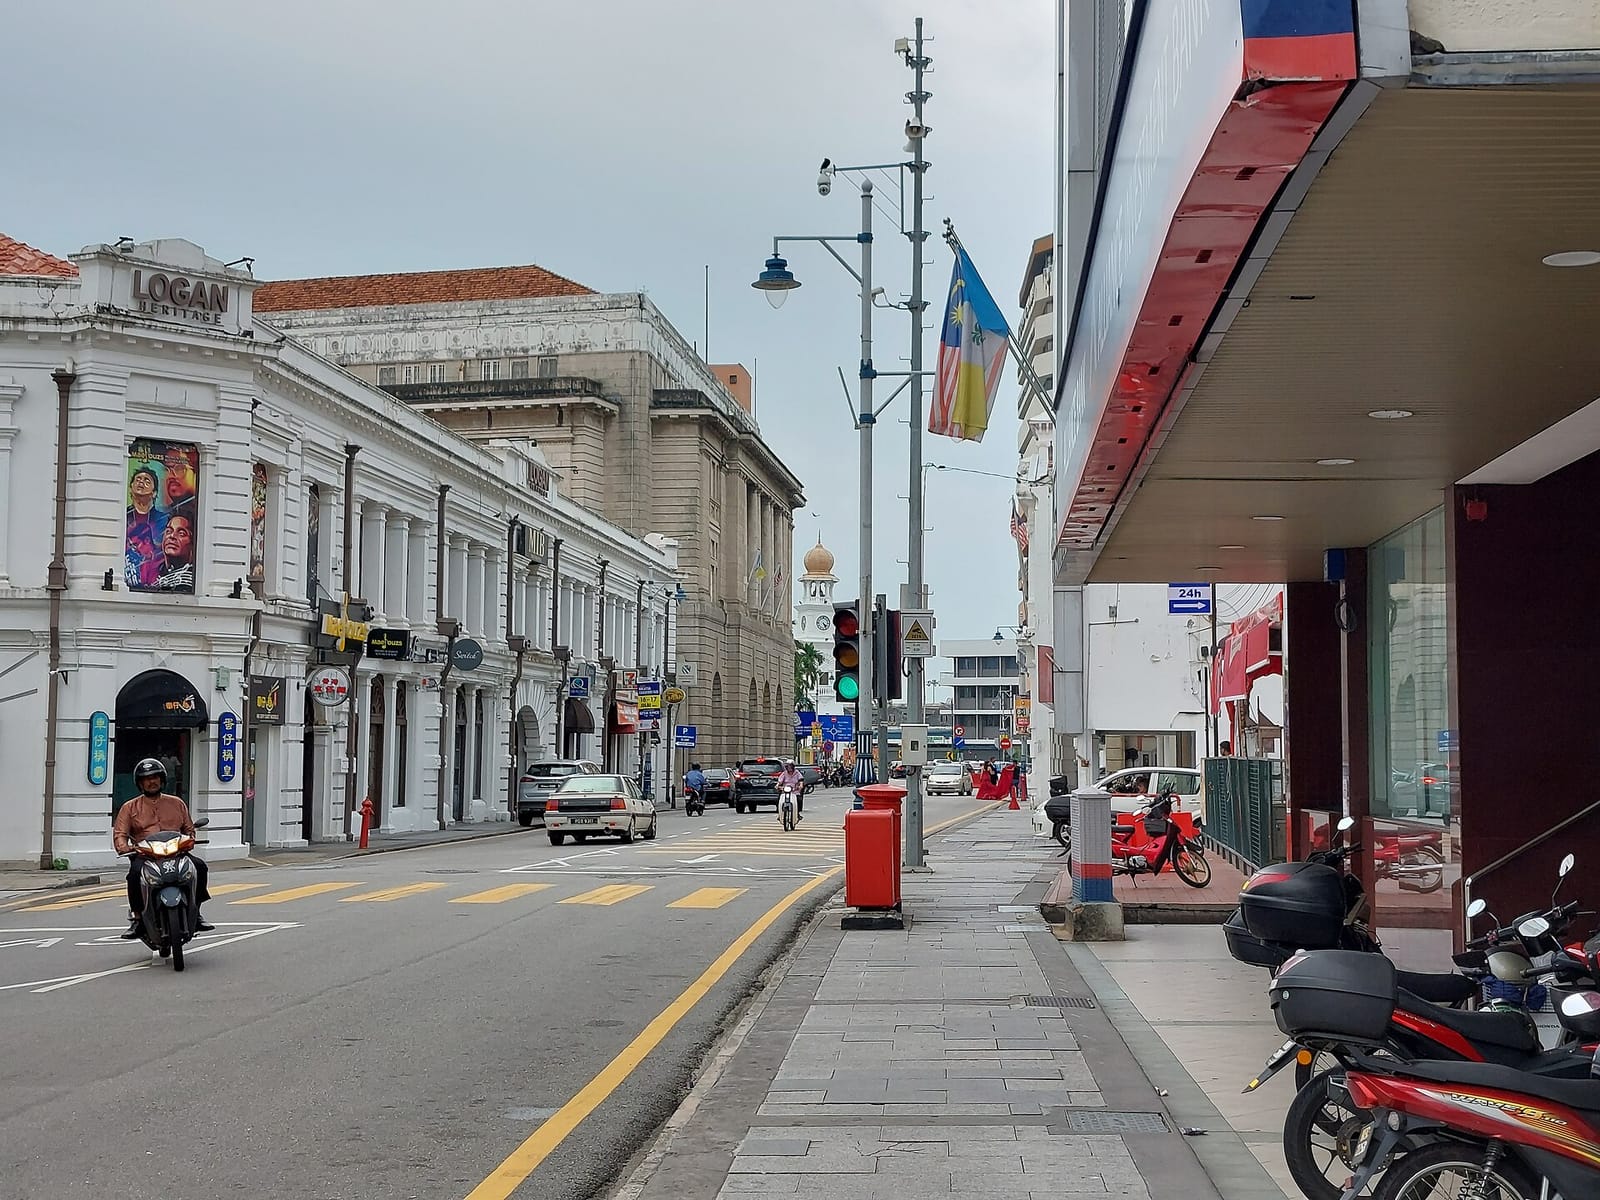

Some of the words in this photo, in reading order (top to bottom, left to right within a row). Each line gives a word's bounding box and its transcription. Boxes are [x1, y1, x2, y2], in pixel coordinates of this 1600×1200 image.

[1172, 0, 1210, 109] BAN
[133, 269, 229, 313] LOGAN
[139, 300, 222, 324] HERITAGE
[1179, 588, 1201, 598] 24h
